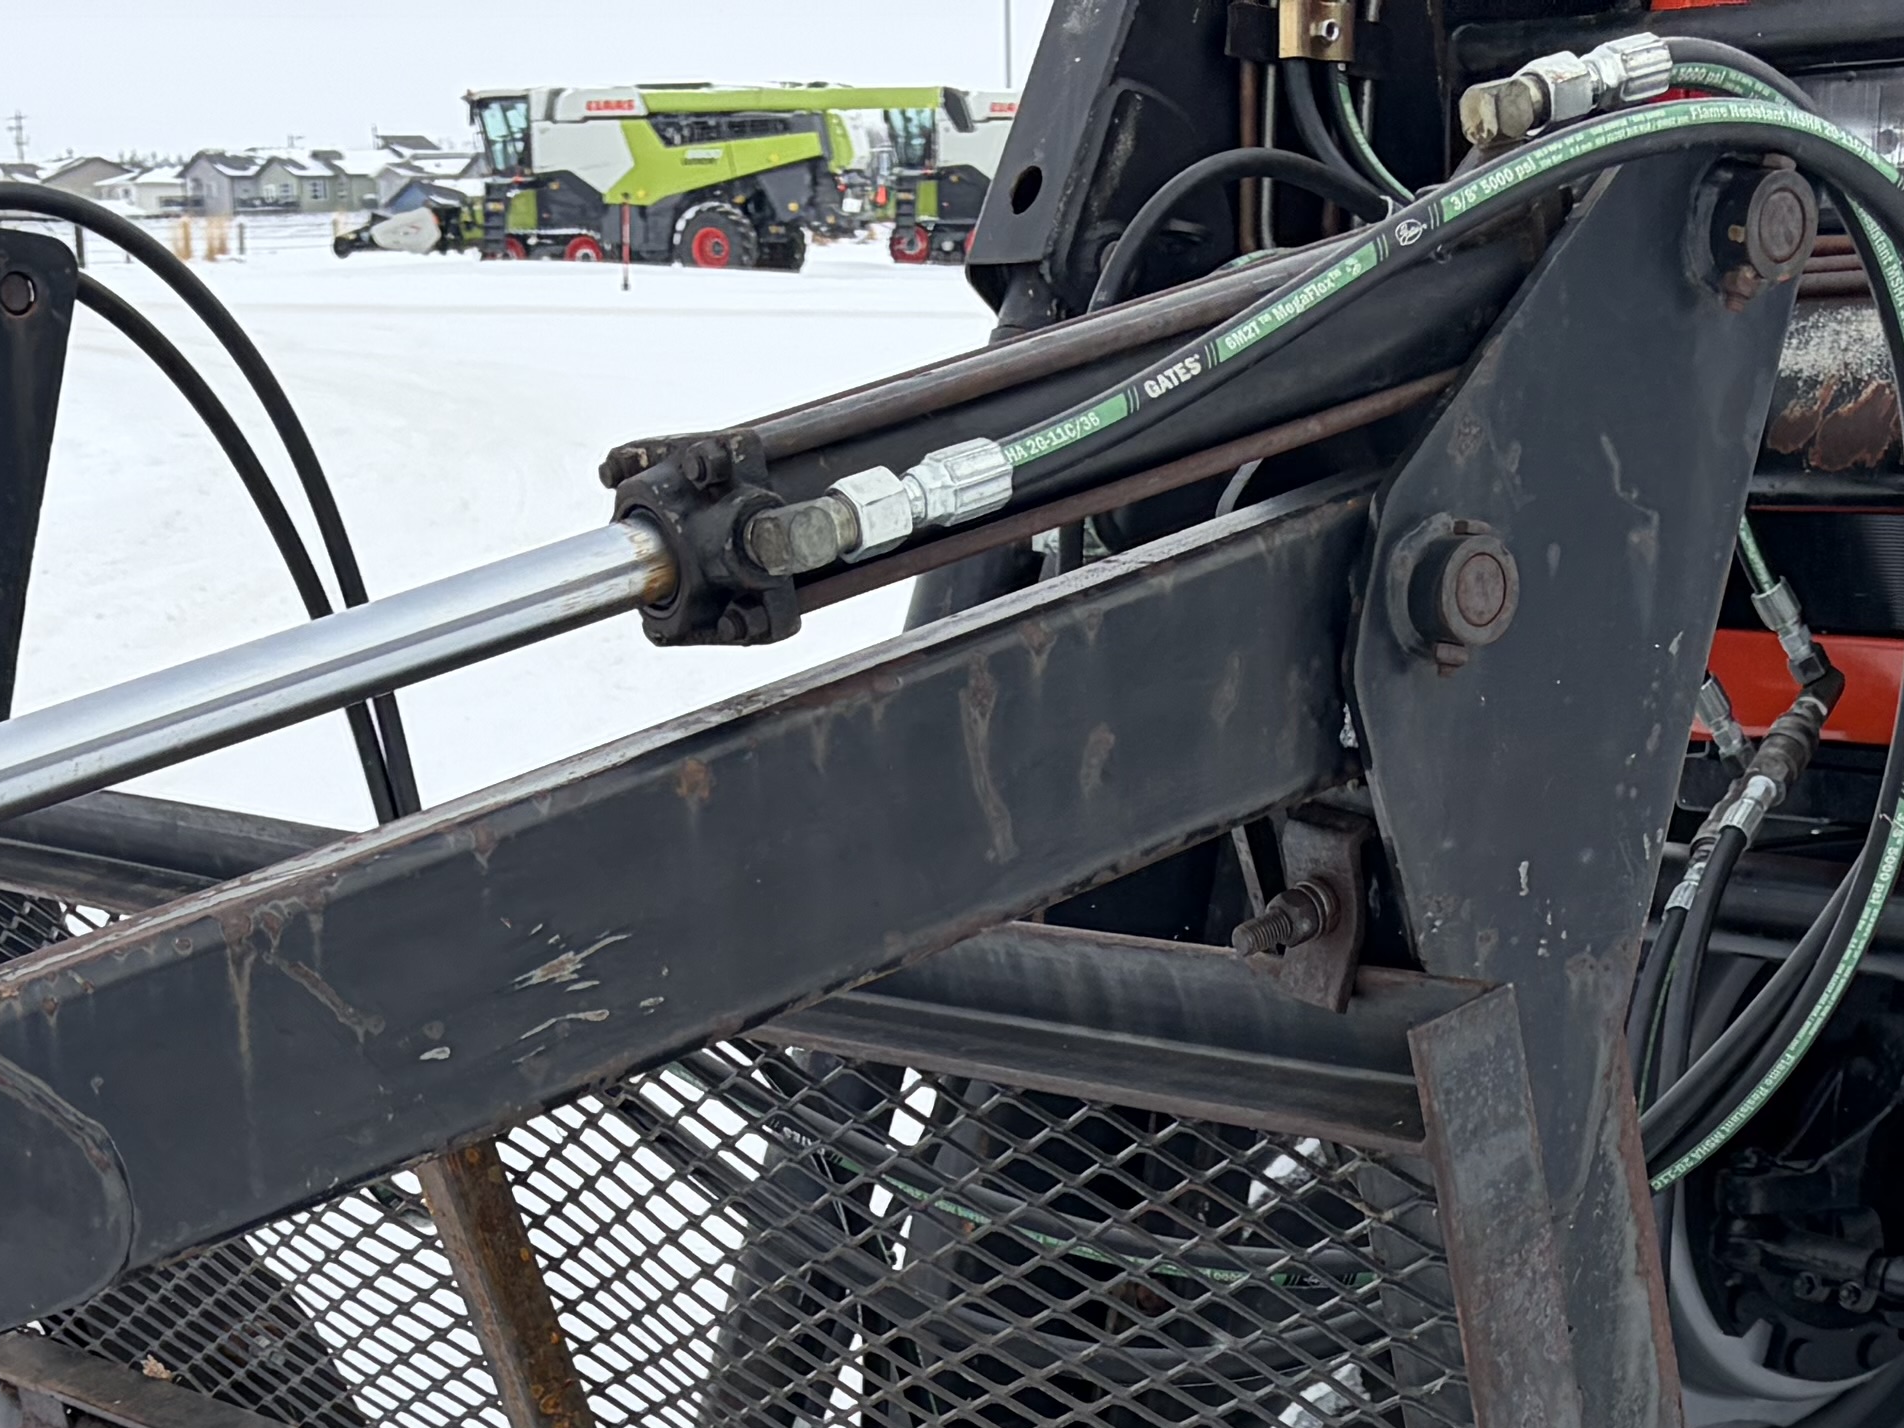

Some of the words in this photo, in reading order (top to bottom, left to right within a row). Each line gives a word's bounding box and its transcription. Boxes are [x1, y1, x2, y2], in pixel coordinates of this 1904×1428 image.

[1690, 105, 1728, 121] Flame
[1481, 167, 1515, 195] 5000
[1516, 157, 1536, 182] psi
[1143, 354, 1202, 399] GATES
[1004, 446, 1028, 463] HA
[1879, 847, 1900, 882] 5000
[1650, 1157, 1695, 1191] 2G-11C
